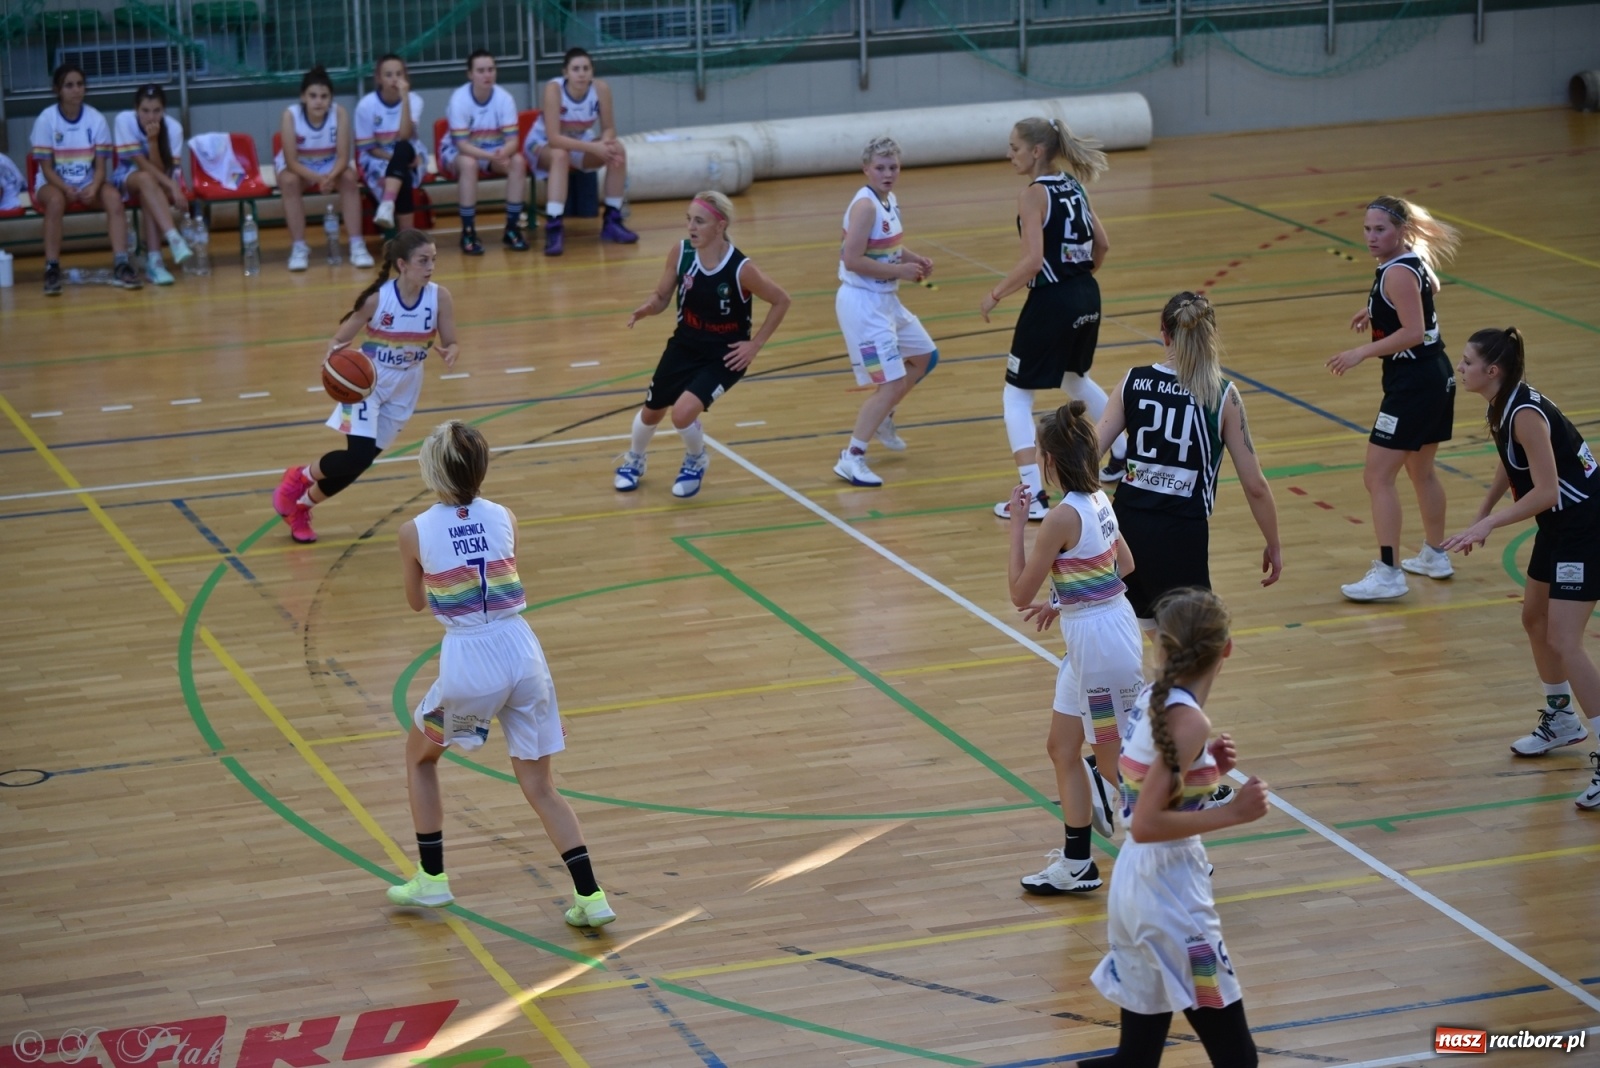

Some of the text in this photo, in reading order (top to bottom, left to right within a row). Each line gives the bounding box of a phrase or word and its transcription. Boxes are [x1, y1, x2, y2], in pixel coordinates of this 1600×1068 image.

[720, 300, 731, 316] 5
[424, 307, 432, 330] 2
[1132, 379, 1153, 391] RKK
[358, 400, 368, 421] 2
[1136, 399, 1194, 462] 24
[448, 523, 486, 539] KAMIENICA
[452, 536, 489, 556] POLSKA
[466, 557, 488, 614] 7
